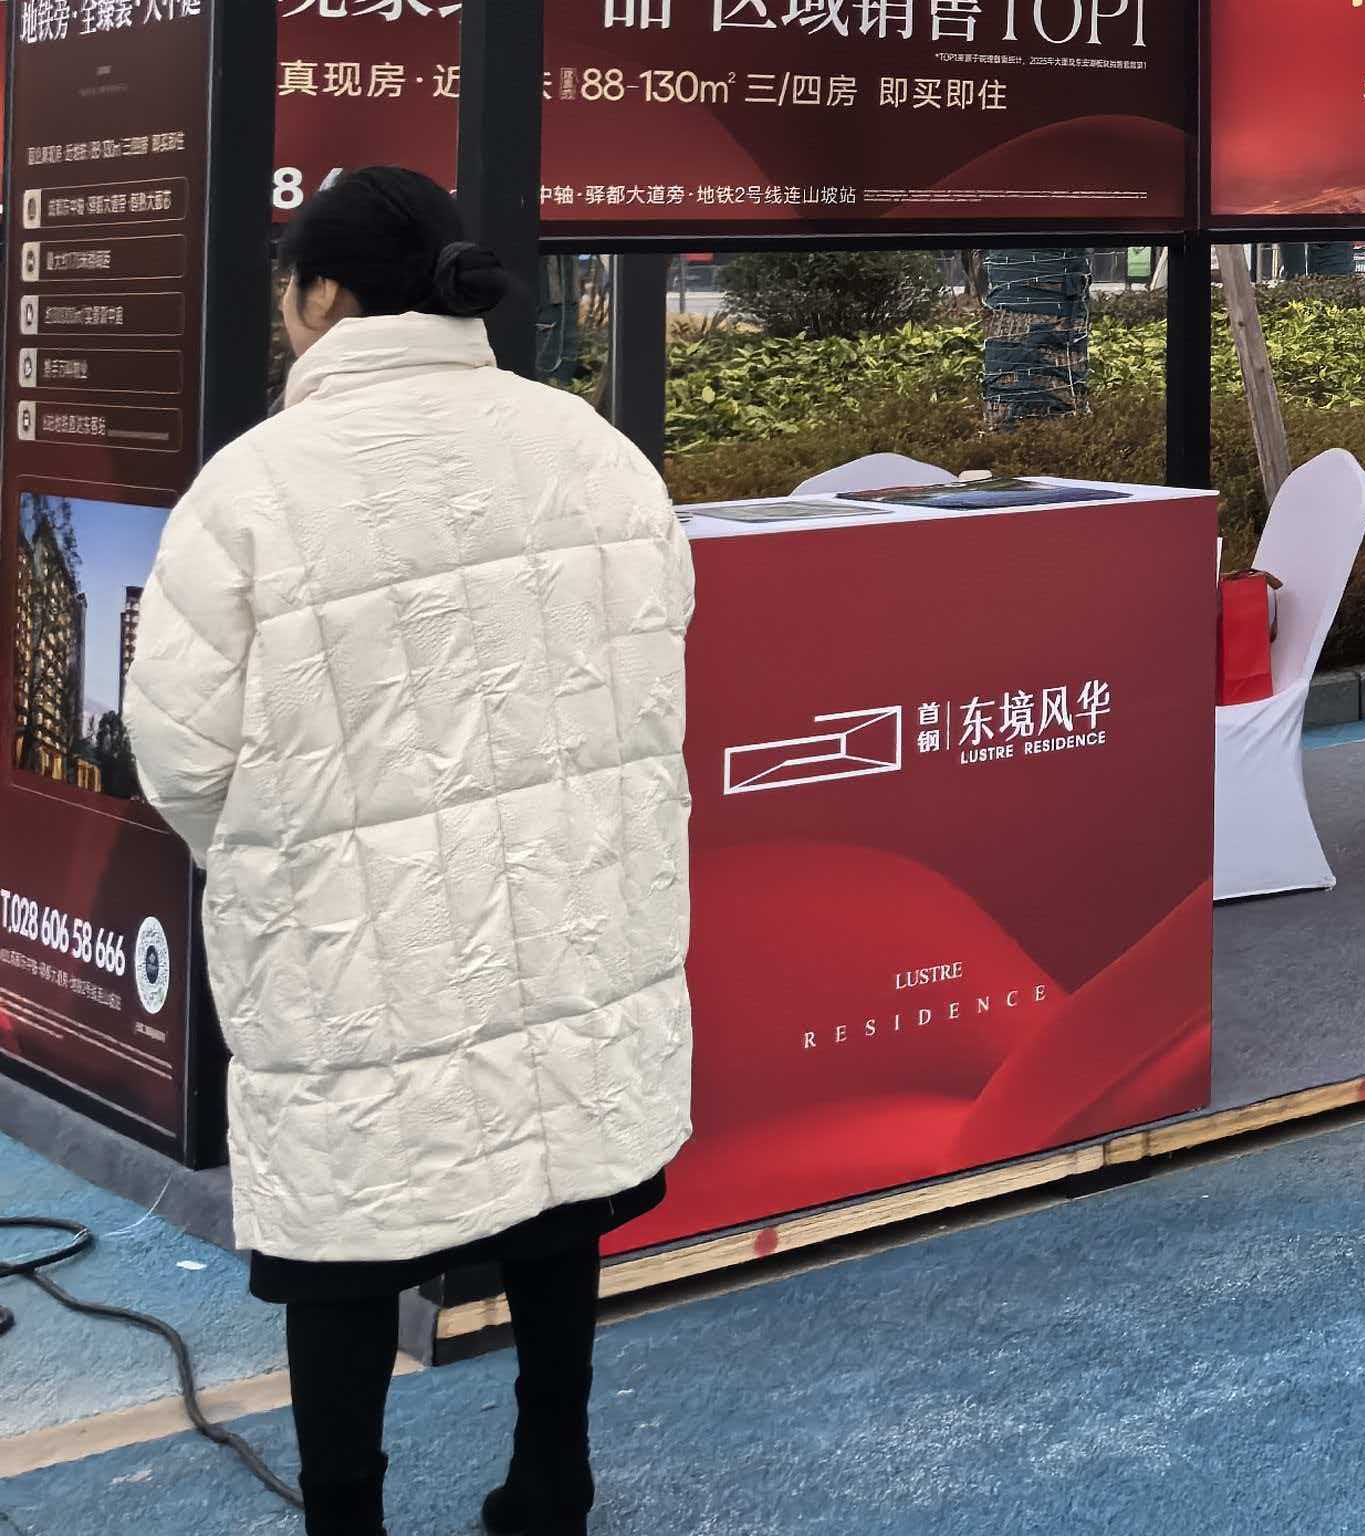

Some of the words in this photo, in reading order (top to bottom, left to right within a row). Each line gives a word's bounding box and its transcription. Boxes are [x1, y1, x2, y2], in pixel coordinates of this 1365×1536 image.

[744, 73, 858, 108] 三/四房
[879, 77, 1007, 111] 即买即住
[917, 701, 940, 753] 首钢
[958, 679, 1111, 748] 东境风华
[960, 744, 1014, 764] LUSTRE
[1023, 730, 1106, 756] RESIDENCE
[1, 889, 38, 941] T.028
[40, 907, 69, 954] 606
[72, 918, 92, 963] 58
[95, 927, 125, 976] 666
[895, 961, 964, 990] LUSTRE
[803, 984, 1047, 1049] RESIDENCE
